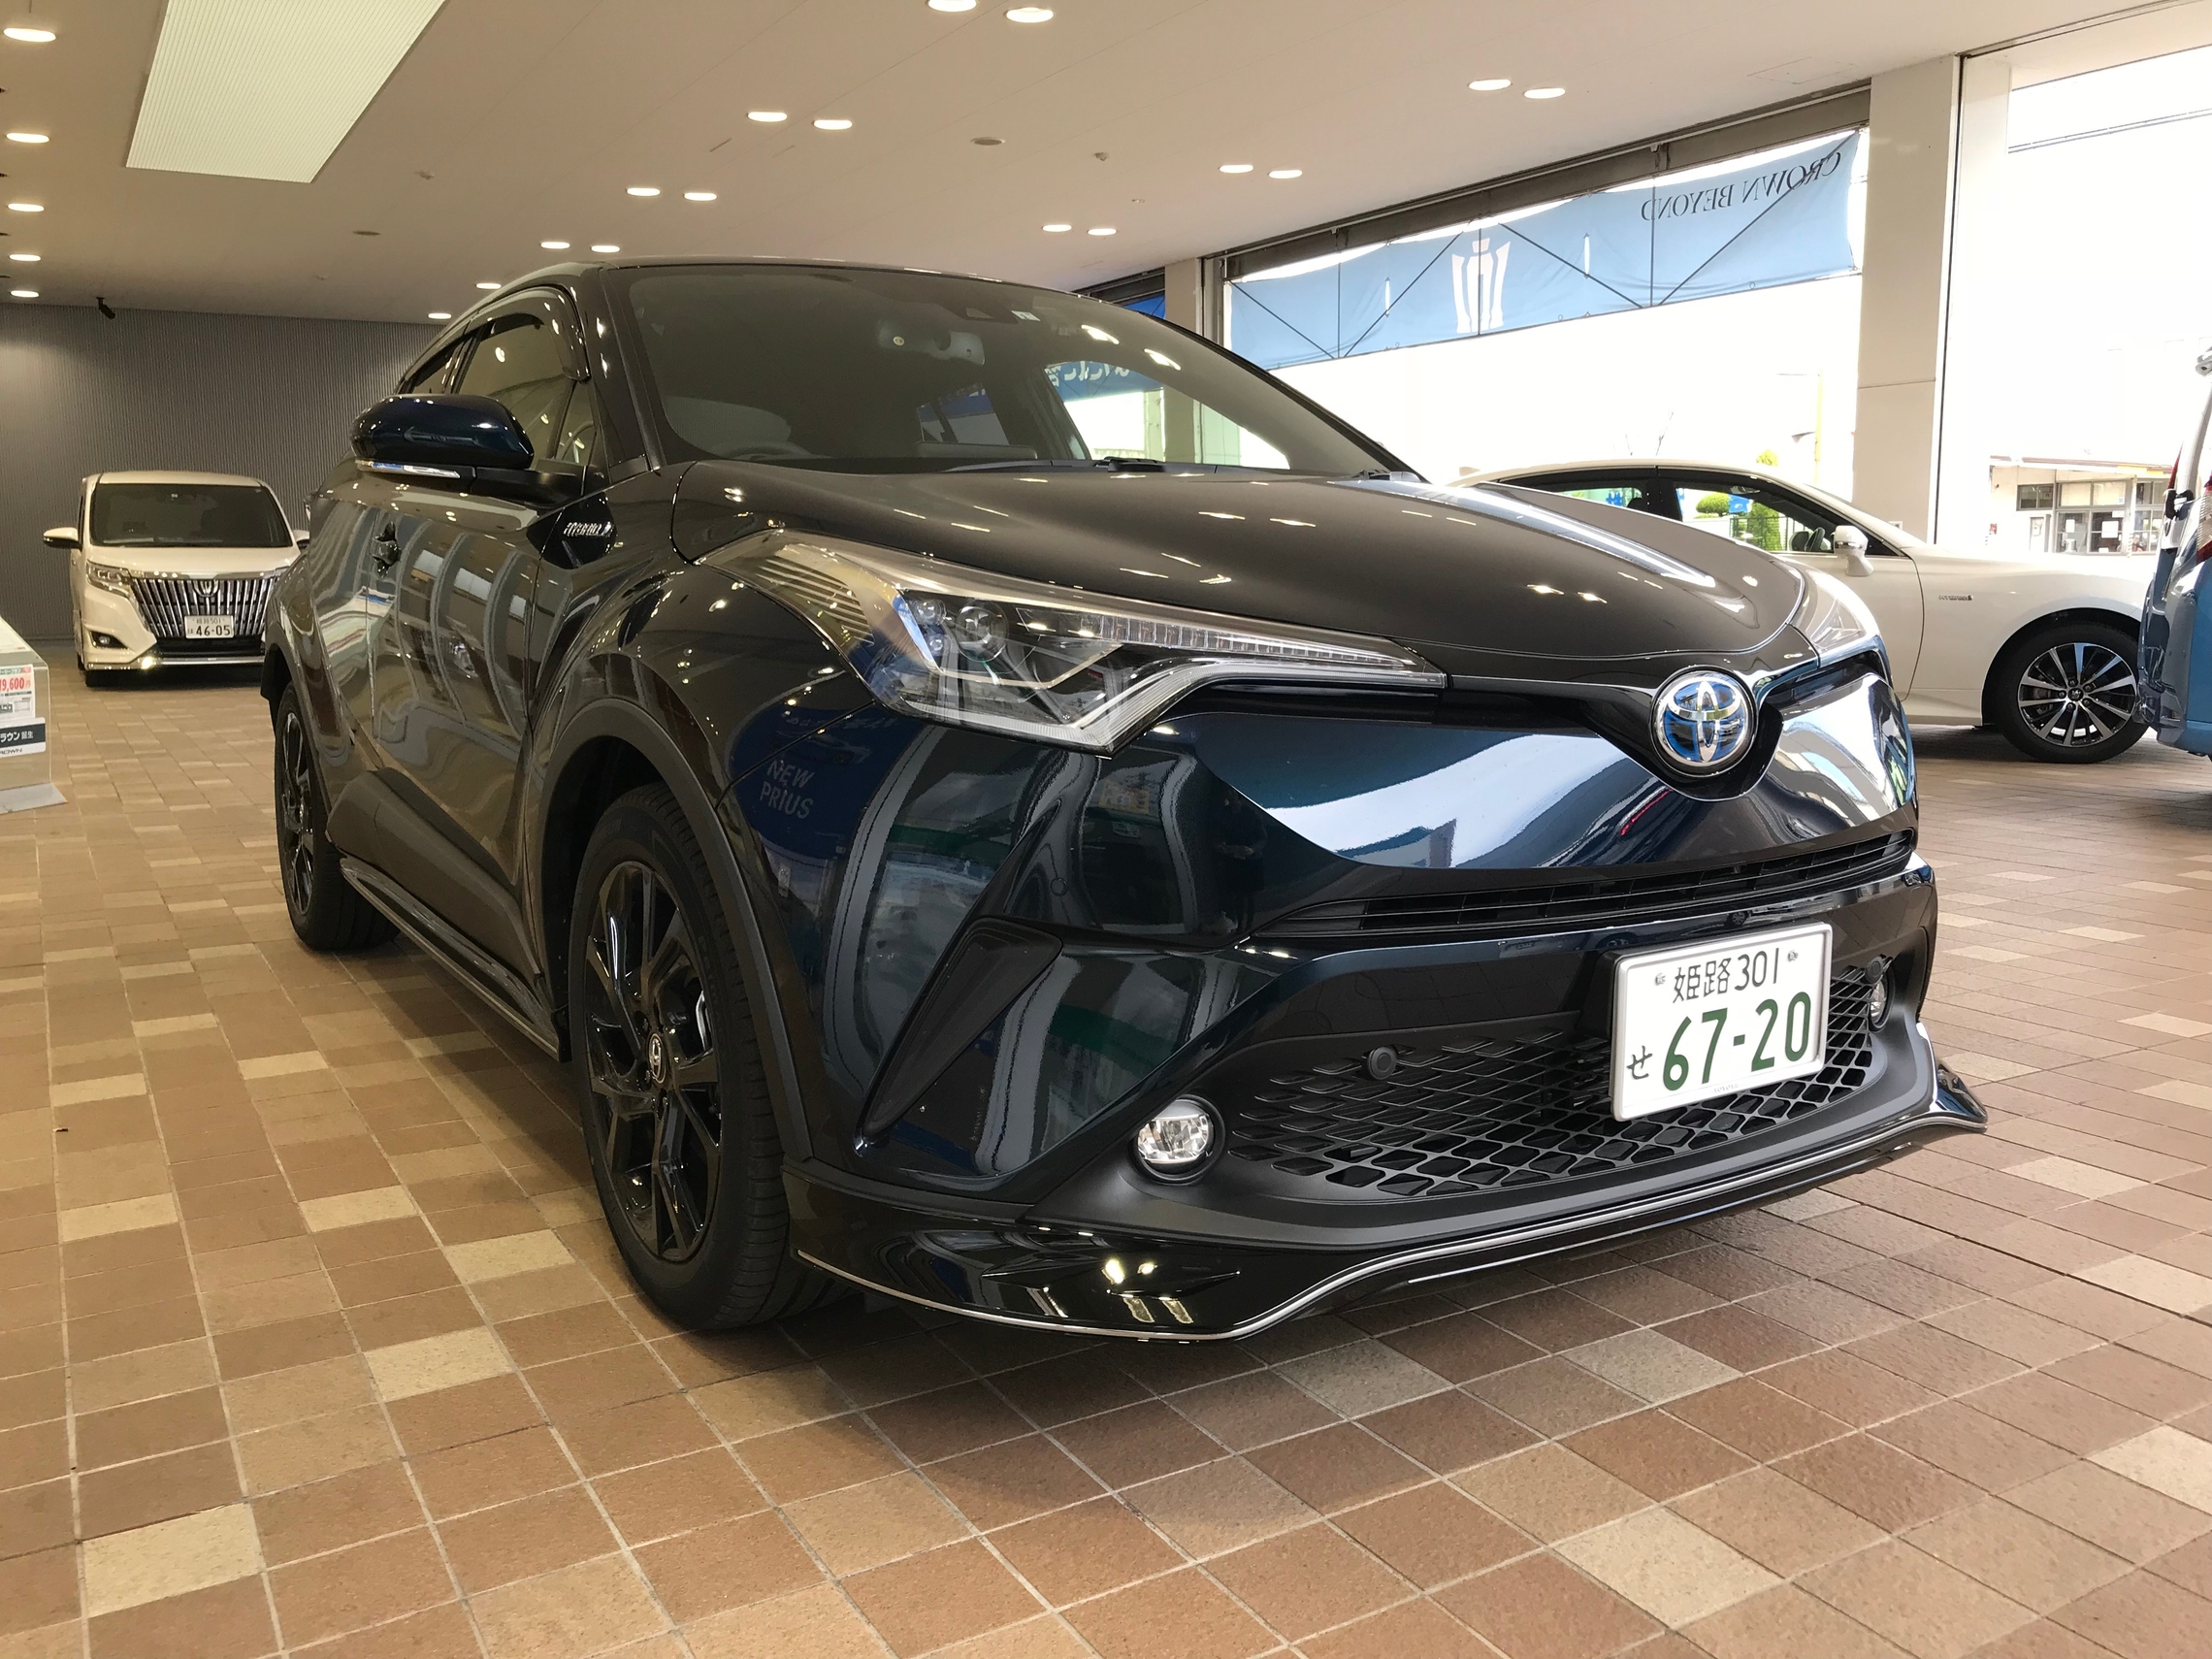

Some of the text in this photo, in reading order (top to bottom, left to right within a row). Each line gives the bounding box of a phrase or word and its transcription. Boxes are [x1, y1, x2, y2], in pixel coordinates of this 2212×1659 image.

[196, 625, 230, 635] 46-05
[766, 760, 815, 788] NEW
[760, 780, 814, 819] PRIUS
[1626, 992, 1811, 1091] せ 67-20
